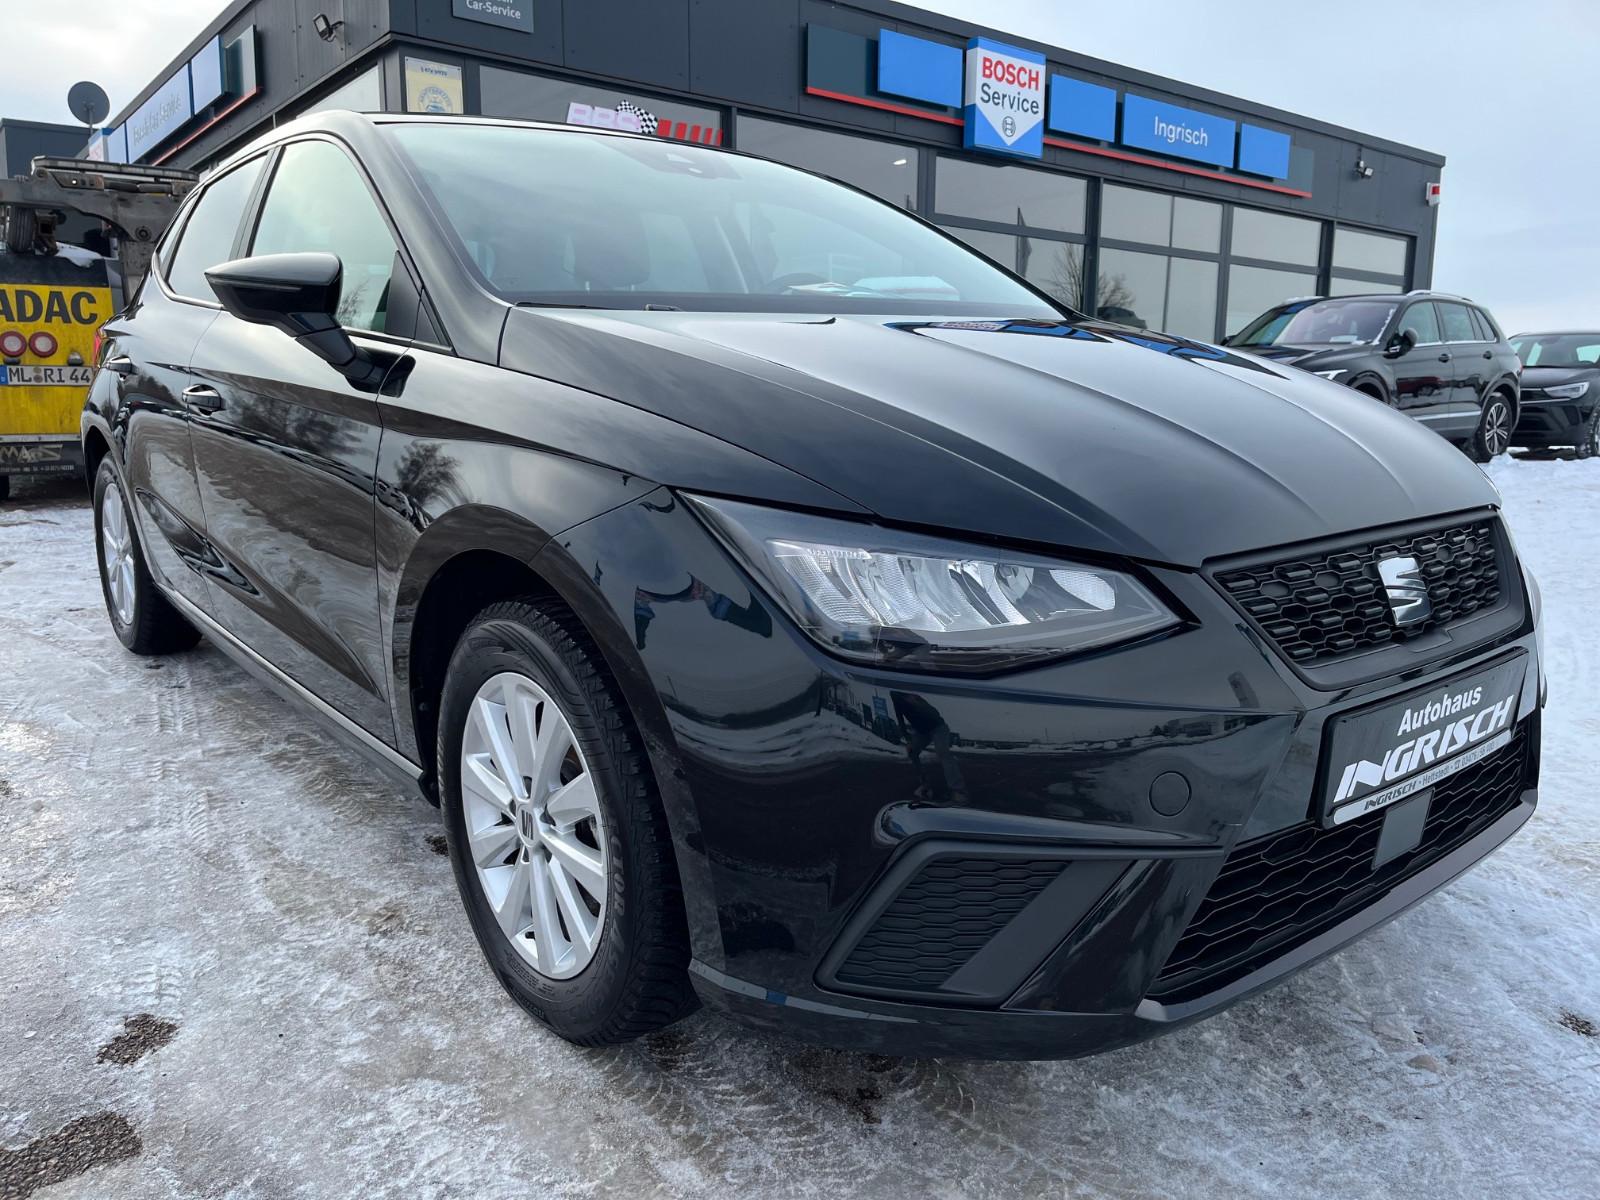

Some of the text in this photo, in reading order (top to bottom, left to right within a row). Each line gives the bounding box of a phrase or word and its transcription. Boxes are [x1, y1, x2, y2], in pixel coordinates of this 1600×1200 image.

[466, 0, 521, 19] Car-Service
[981, 57, 1040, 92] BOSCH
[980, 82, 1040, 115] Service
[1154, 116, 1208, 147] Ingrisch
[0, 289, 98, 325] ADAC
[9, 367, 32, 382] ML
[43, 367, 65, 383] RI
[1397, 686, 1482, 736] Autohaus
[1333, 694, 1515, 803] INGRISCH
[1364, 780, 1417, 811] INGRISCH
